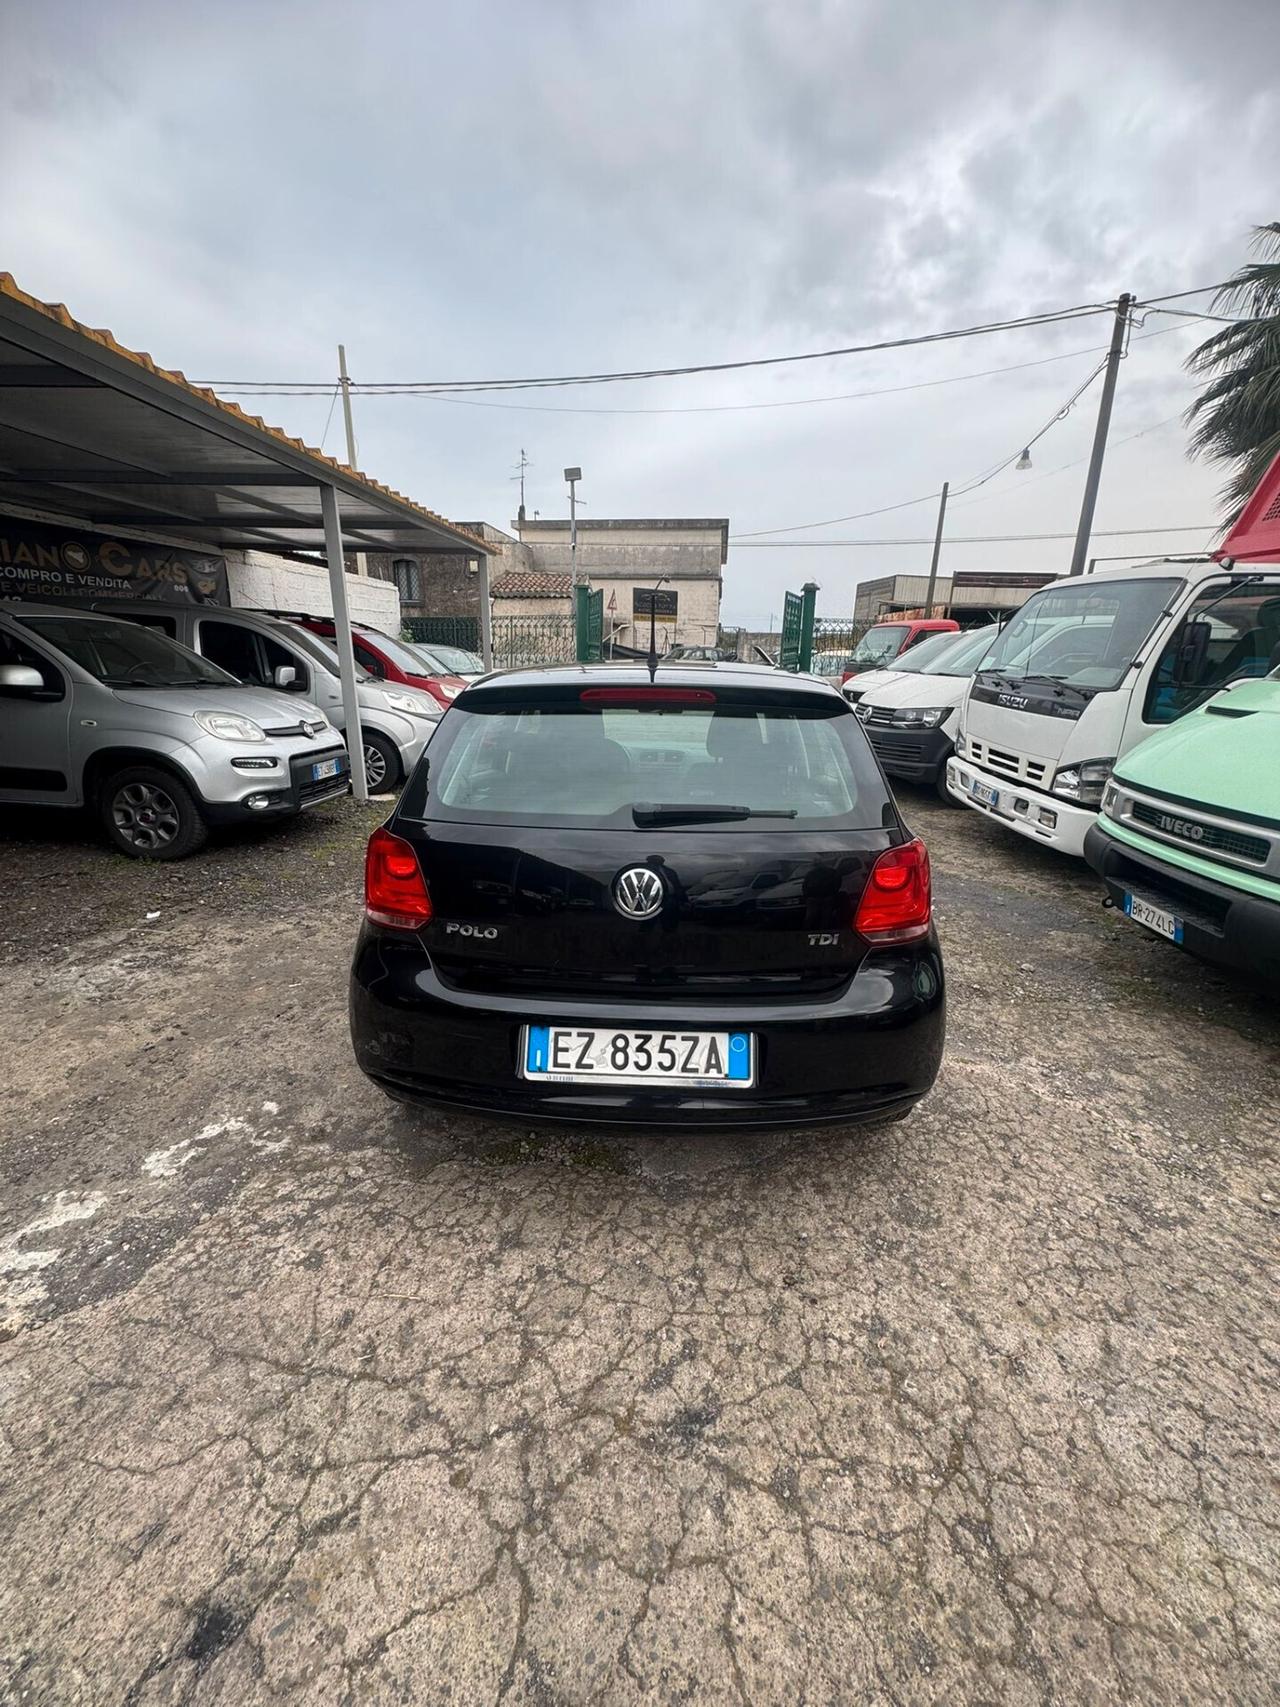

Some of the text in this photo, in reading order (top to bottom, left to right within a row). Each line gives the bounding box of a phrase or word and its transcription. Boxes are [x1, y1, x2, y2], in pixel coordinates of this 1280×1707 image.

[67, 573, 75, 584] E
[78, 575, 132, 589] VENDITA
[999, 694, 1028, 709] ISUZU
[1160, 815, 1204, 840] IVECO
[446, 922, 498, 939] POLO
[807, 933, 840, 946] TDI
[552, 1031, 724, 1075] EZ 835ZA
